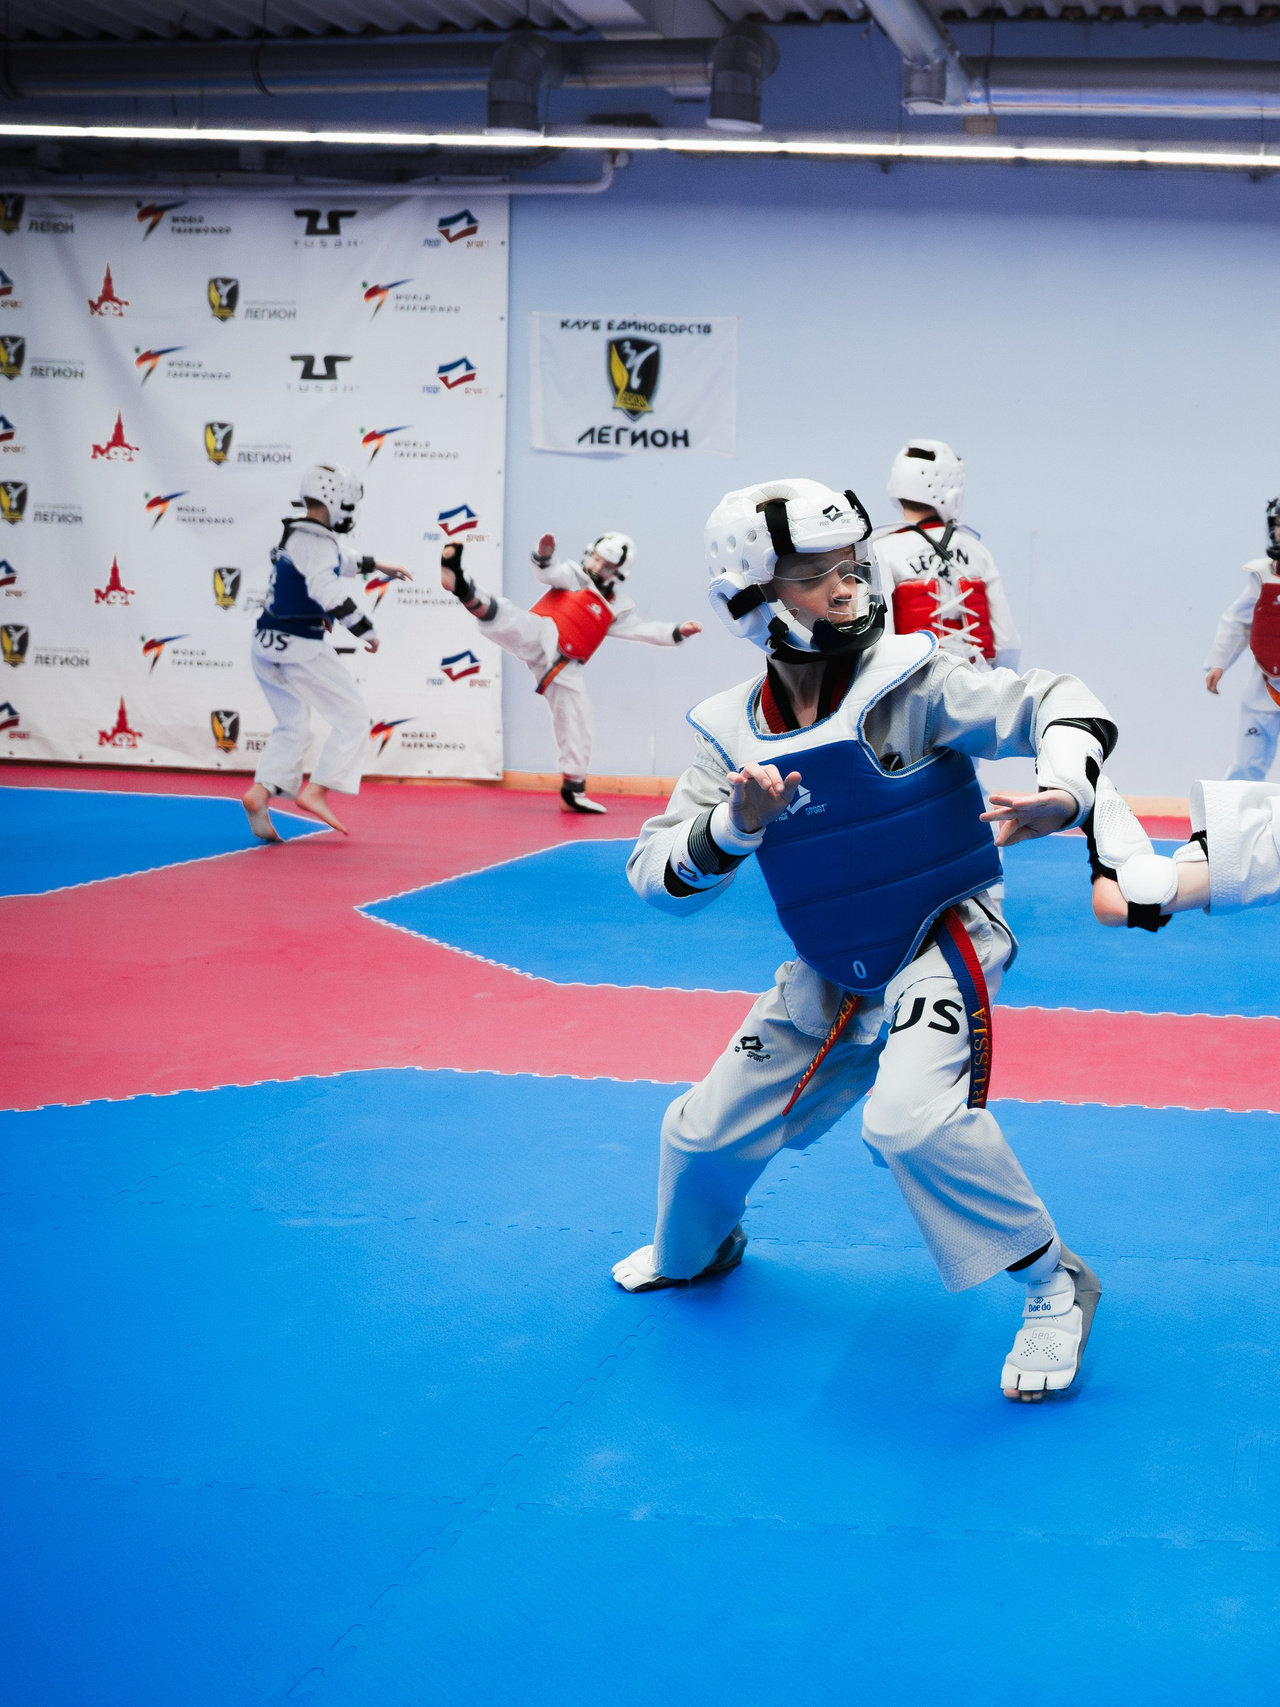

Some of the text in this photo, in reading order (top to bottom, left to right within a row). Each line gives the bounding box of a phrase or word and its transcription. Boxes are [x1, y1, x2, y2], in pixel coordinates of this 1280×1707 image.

[560, 319, 712, 334] КЛУБ ЕДИНОБОРСТВ
[577, 425, 690, 448] ЛЕГИОН
[805, 804, 826, 815] SPORT
[971, 1007, 989, 1108] RUSSIA
[1031, 1329, 1057, 1341] Gen2
